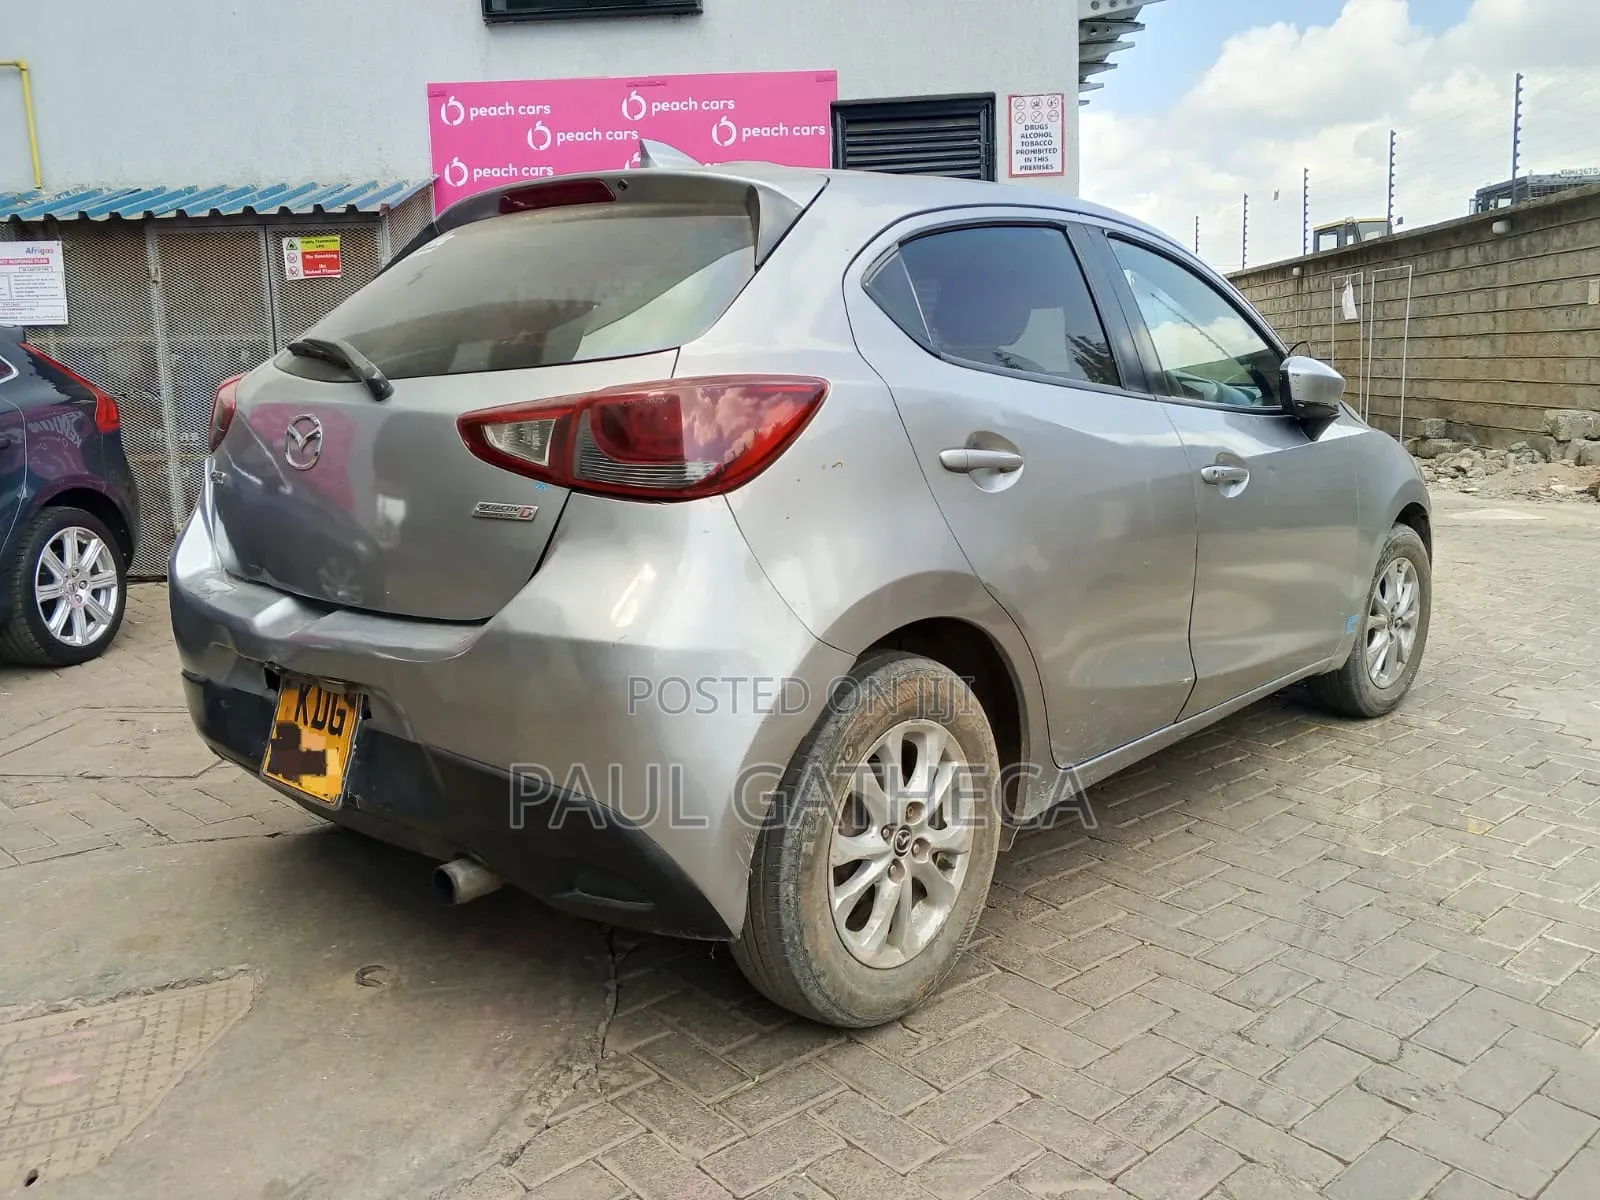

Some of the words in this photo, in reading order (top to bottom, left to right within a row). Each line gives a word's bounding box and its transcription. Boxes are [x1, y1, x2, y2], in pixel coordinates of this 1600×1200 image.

[469, 102, 515, 120] peach
[518, 103, 551, 115] cars
[651, 97, 698, 116] peach
[701, 99, 736, 110] cars
[742, 122, 789, 142] peach
[792, 124, 826, 136] cars
[1024, 123, 1049, 131] DRUGS
[556, 127, 602, 146] peach
[605, 129, 639, 141] cars
[1021, 139, 1053, 147] TOBACCO
[1015, 147, 1058, 155] PROHIBITED
[473, 163, 518, 182] peach
[521, 165, 554, 177] cars
[25, 246, 54, 255] Afrigas
